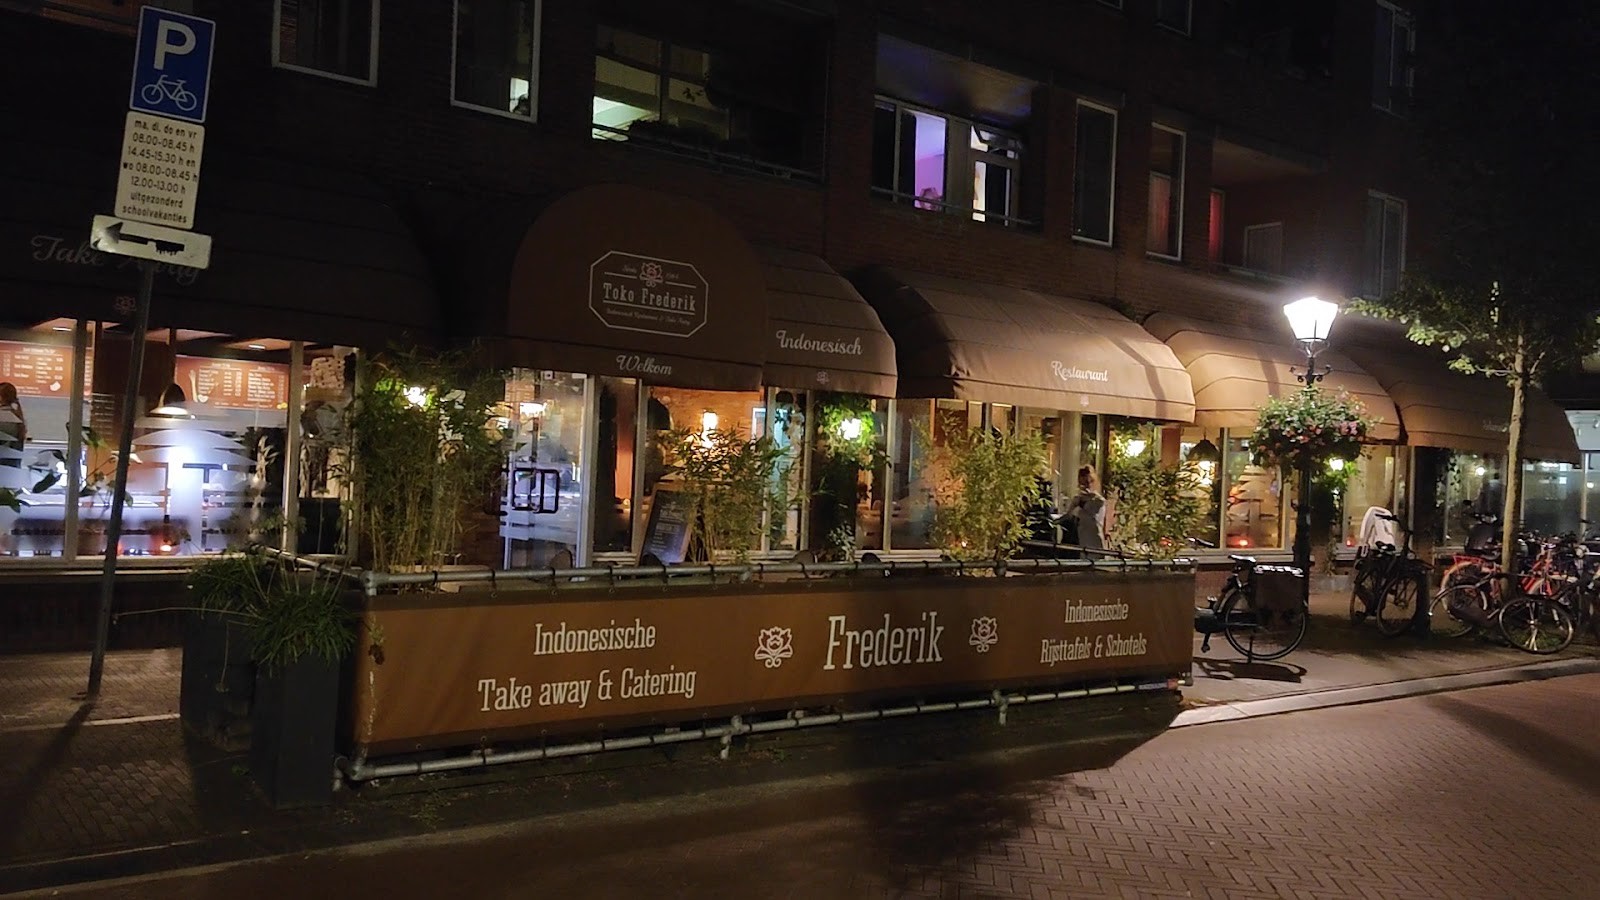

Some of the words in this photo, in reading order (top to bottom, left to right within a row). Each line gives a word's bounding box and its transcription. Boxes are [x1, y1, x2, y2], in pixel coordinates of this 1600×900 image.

[153, 18, 197, 71] P
[133, 132, 187, 151] 08.00-08.45
[189, 144, 195, 153] h
[164, 125, 173, 134] do
[175, 129, 186, 137] en
[188, 131, 197, 139] vr
[128, 146, 176, 164] 14.45-15.30
[178, 156, 184, 165] h
[186, 160, 195, 168] en
[136, 162, 190, 181] 08.00-08.45
[131, 176, 178, 193] 12.00-13.00
[180, 184, 186, 195] h
[131, 192, 183, 208] uitgezonderd
[122, 205, 187, 223] schoolvakanties
[31, 235, 104, 266] Take
[602, 282, 635, 302] Toko
[641, 287, 696, 311] Frederik
[776, 330, 863, 356] Indonesisch
[615, 355, 672, 375] Welkom
[1051, 360, 1108, 382] Restaurant
[1065, 598, 1129, 623] Indonesische
[532, 617, 657, 656] Indonesische
[823, 611, 945, 671] Frederik
[1093, 634, 1104, 660] &
[1105, 632, 1148, 658] Schotels
[477, 676, 532, 712] Take
[538, 679, 592, 708] away
[597, 668, 614, 701] &
[620, 664, 697, 699] Catering
